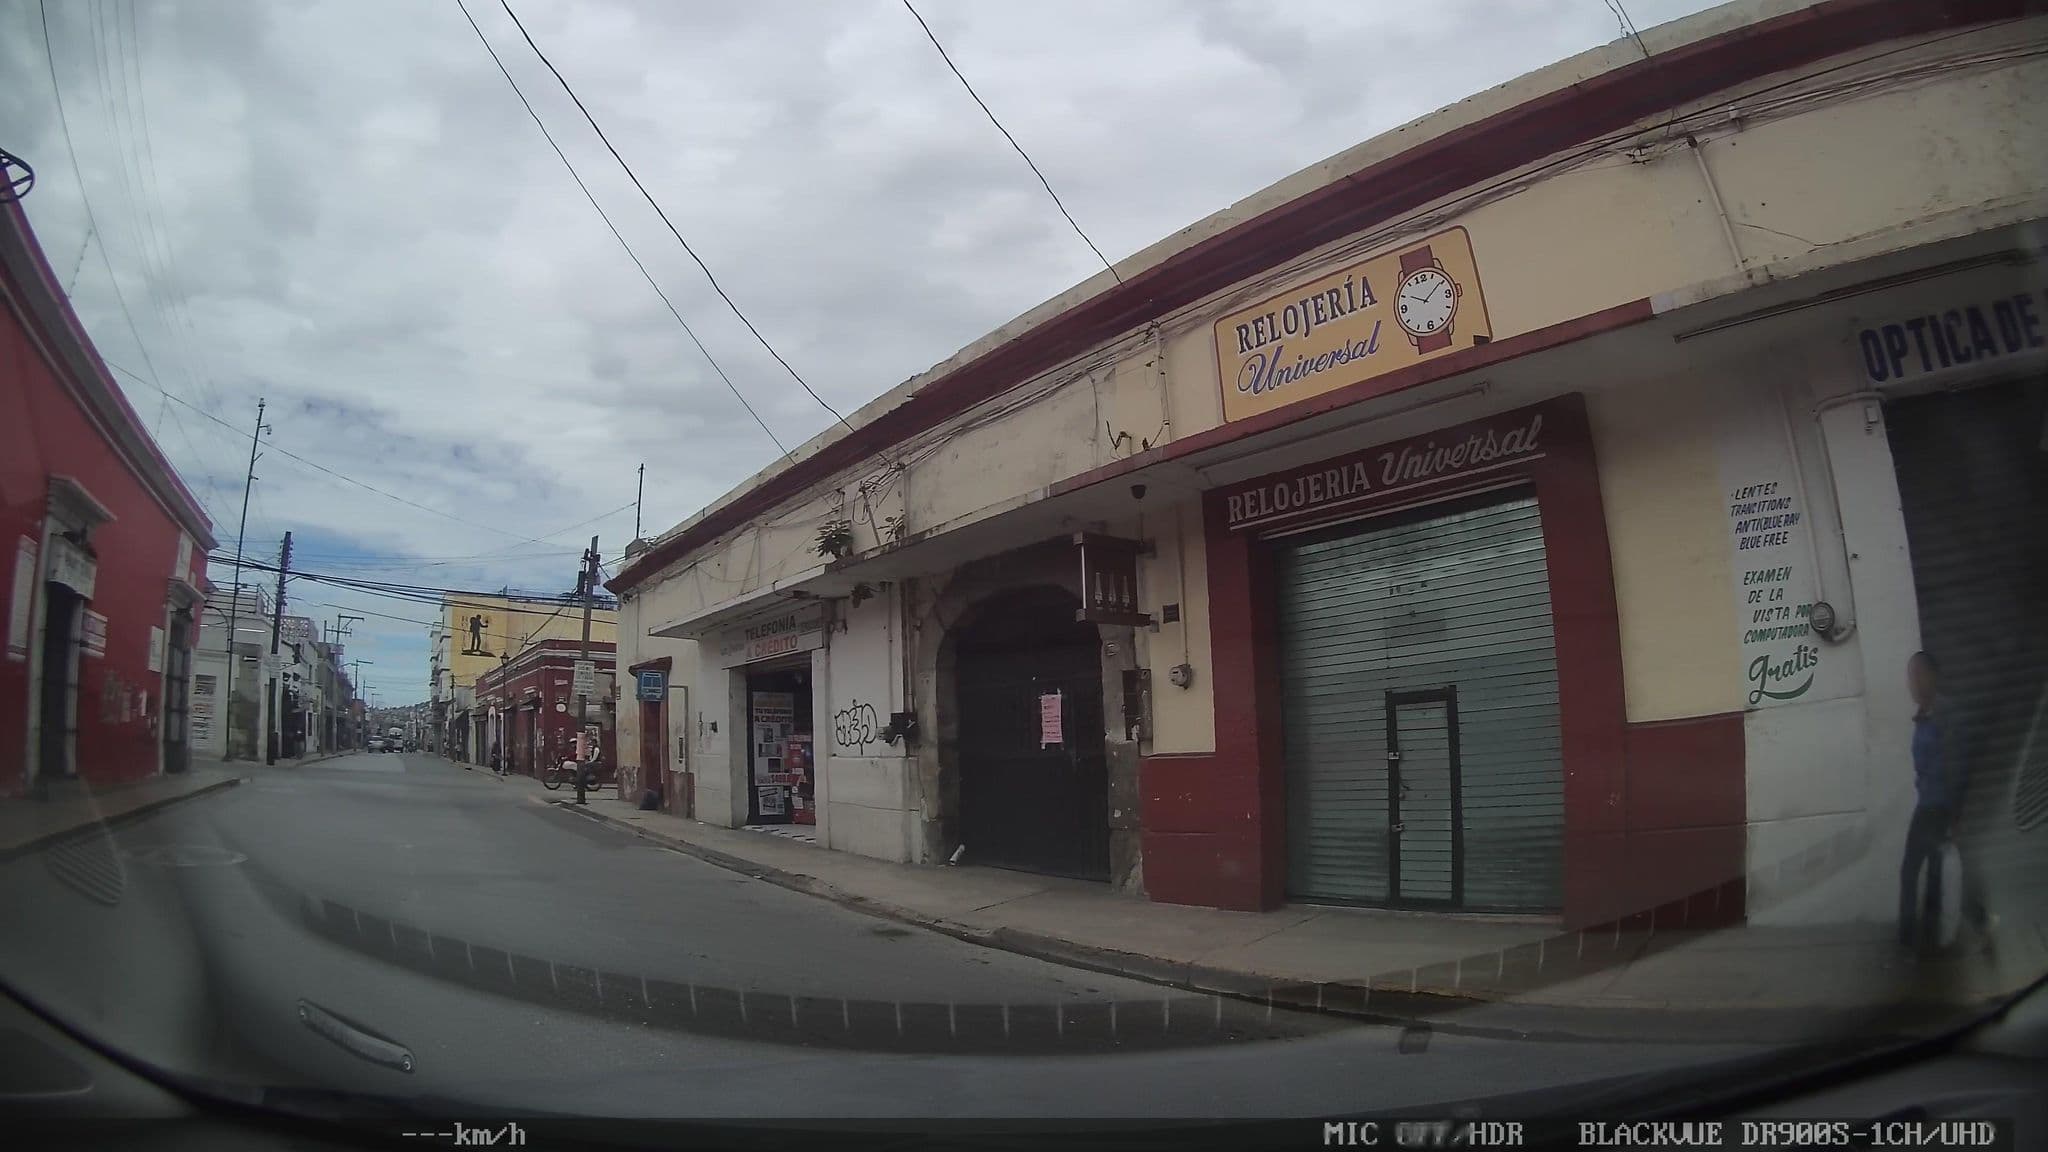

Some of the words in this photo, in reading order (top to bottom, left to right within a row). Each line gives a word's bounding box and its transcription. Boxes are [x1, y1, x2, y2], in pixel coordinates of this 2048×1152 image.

[1414, 274, 1428, 286] 12
[1235, 275, 1379, 355] RELOJERÍA
[1859, 304, 1999, 382] OPTICA
[1992, 293, 2046, 353] DE
[1237, 320, 1382, 395] Universal
[1227, 461, 1371, 523] RELOJERIA
[1377, 414, 1544, 486] Universal
[1734, 482, 1778, 500] LENTES
[1739, 535, 1762, 551] BLUE
[1762, 531, 1789, 547] FREE
[1743, 566, 1793, 586] EXAMEN
[1747, 589, 1764, 604] DE
[1769, 588, 1784, 602] LA
[1752, 606, 1790, 624] VISTA
